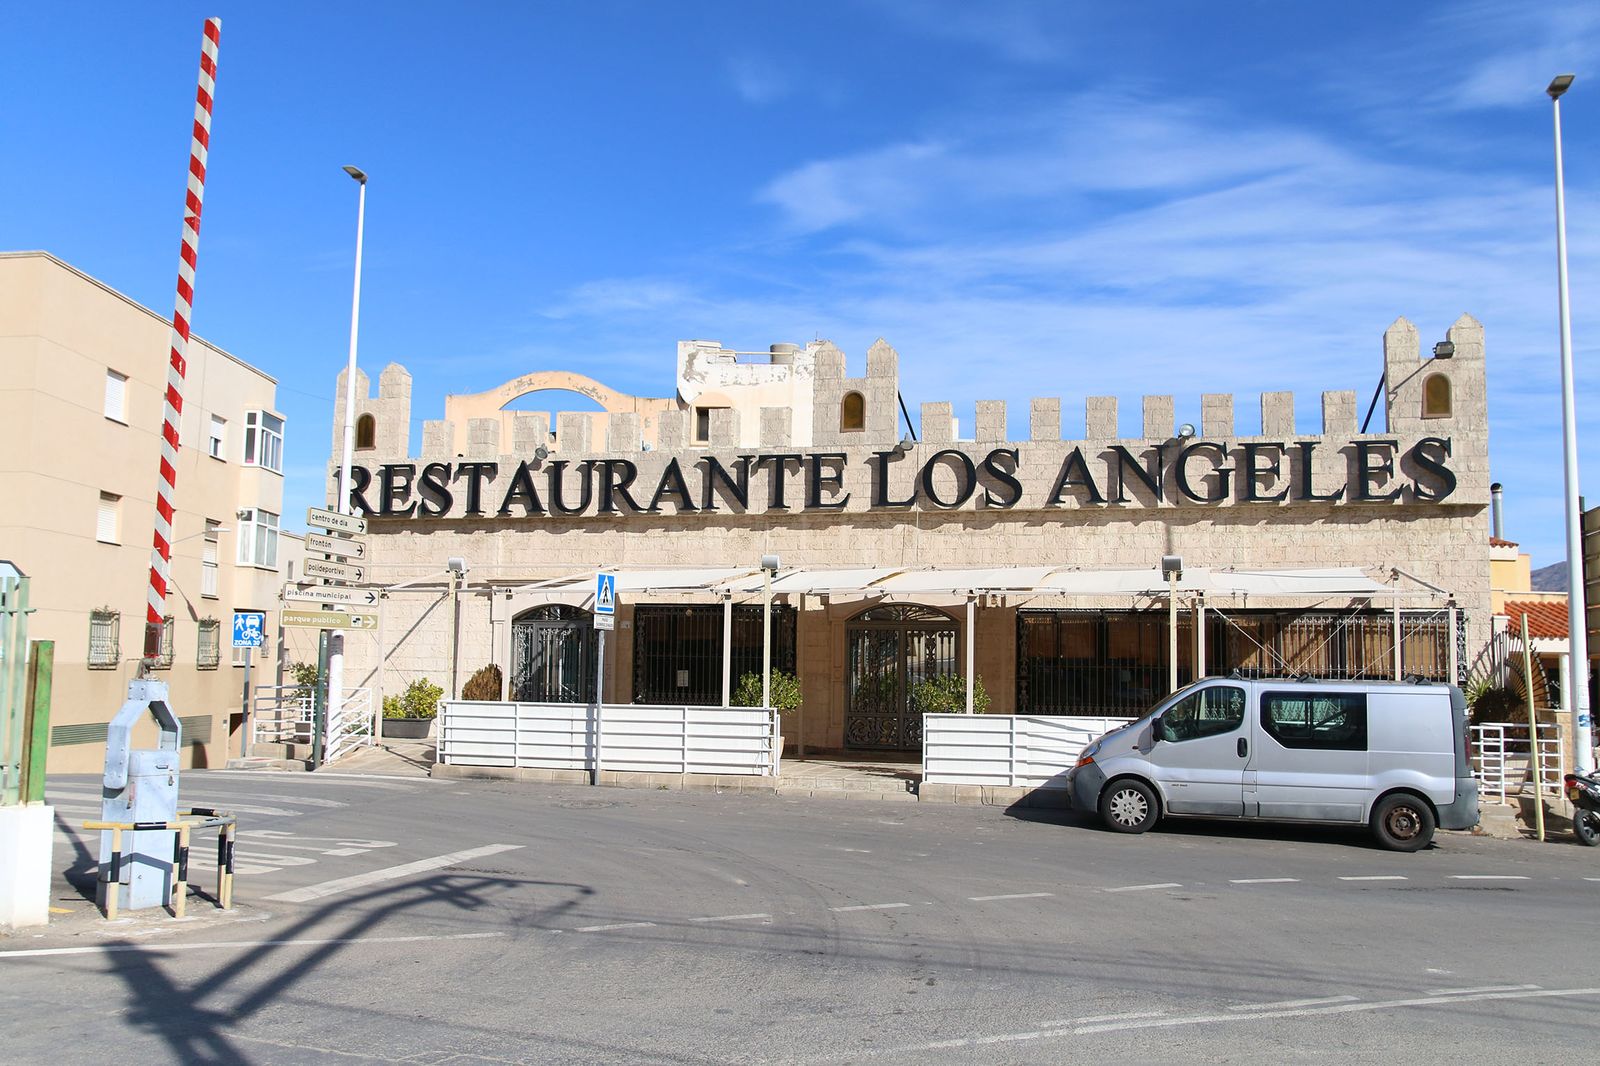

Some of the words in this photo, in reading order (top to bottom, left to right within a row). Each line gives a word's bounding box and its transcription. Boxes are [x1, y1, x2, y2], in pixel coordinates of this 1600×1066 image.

[336, 452, 852, 517] RESTAURANTE
[870, 447, 1022, 512] LOS
[1045, 437, 1457, 508] ANGELES
[311, 513, 330, 523] centro
[331, 517, 338, 525] de
[308, 563, 345, 576] polideportivo
[287, 589, 314, 598] piscina
[315, 591, 351, 600] municipal
[283, 615, 311, 623] parque
